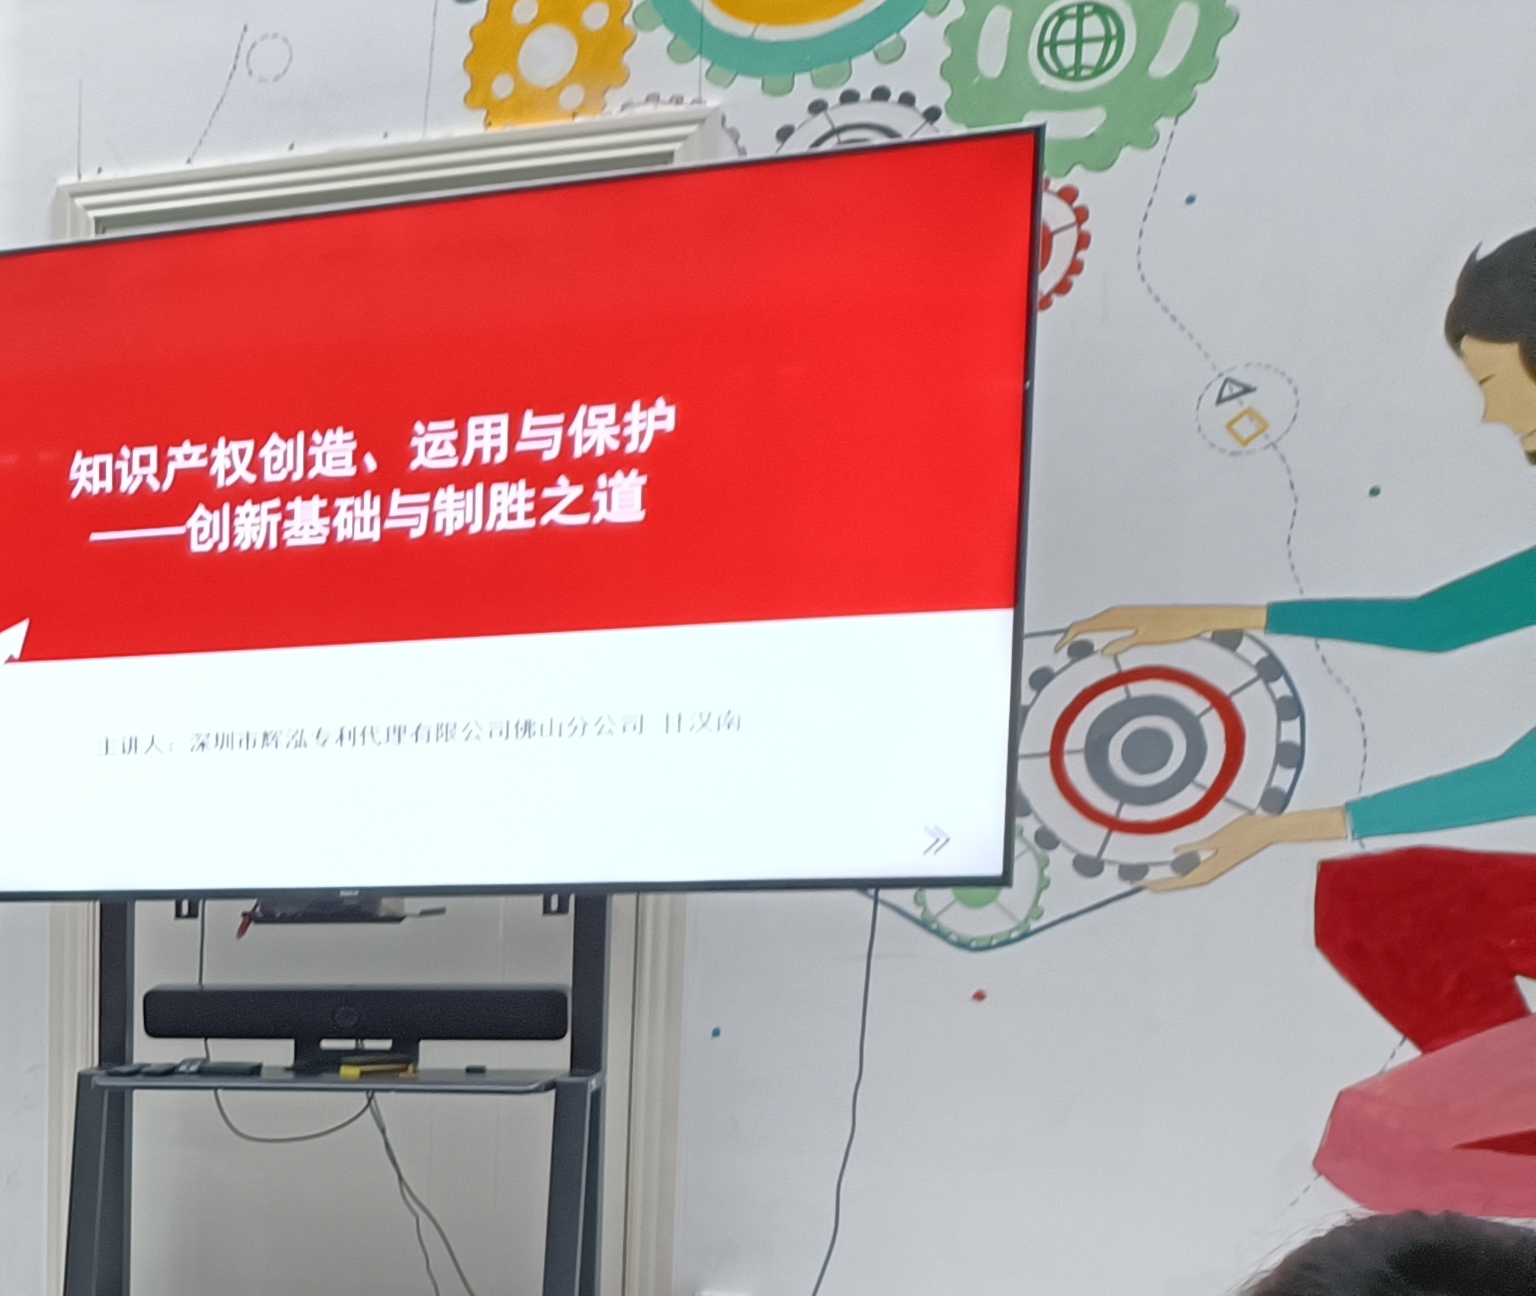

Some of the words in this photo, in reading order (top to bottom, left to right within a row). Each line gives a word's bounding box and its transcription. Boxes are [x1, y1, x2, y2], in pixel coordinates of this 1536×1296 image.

[67, 395, 678, 501] 知识产权创造、运用与保护
